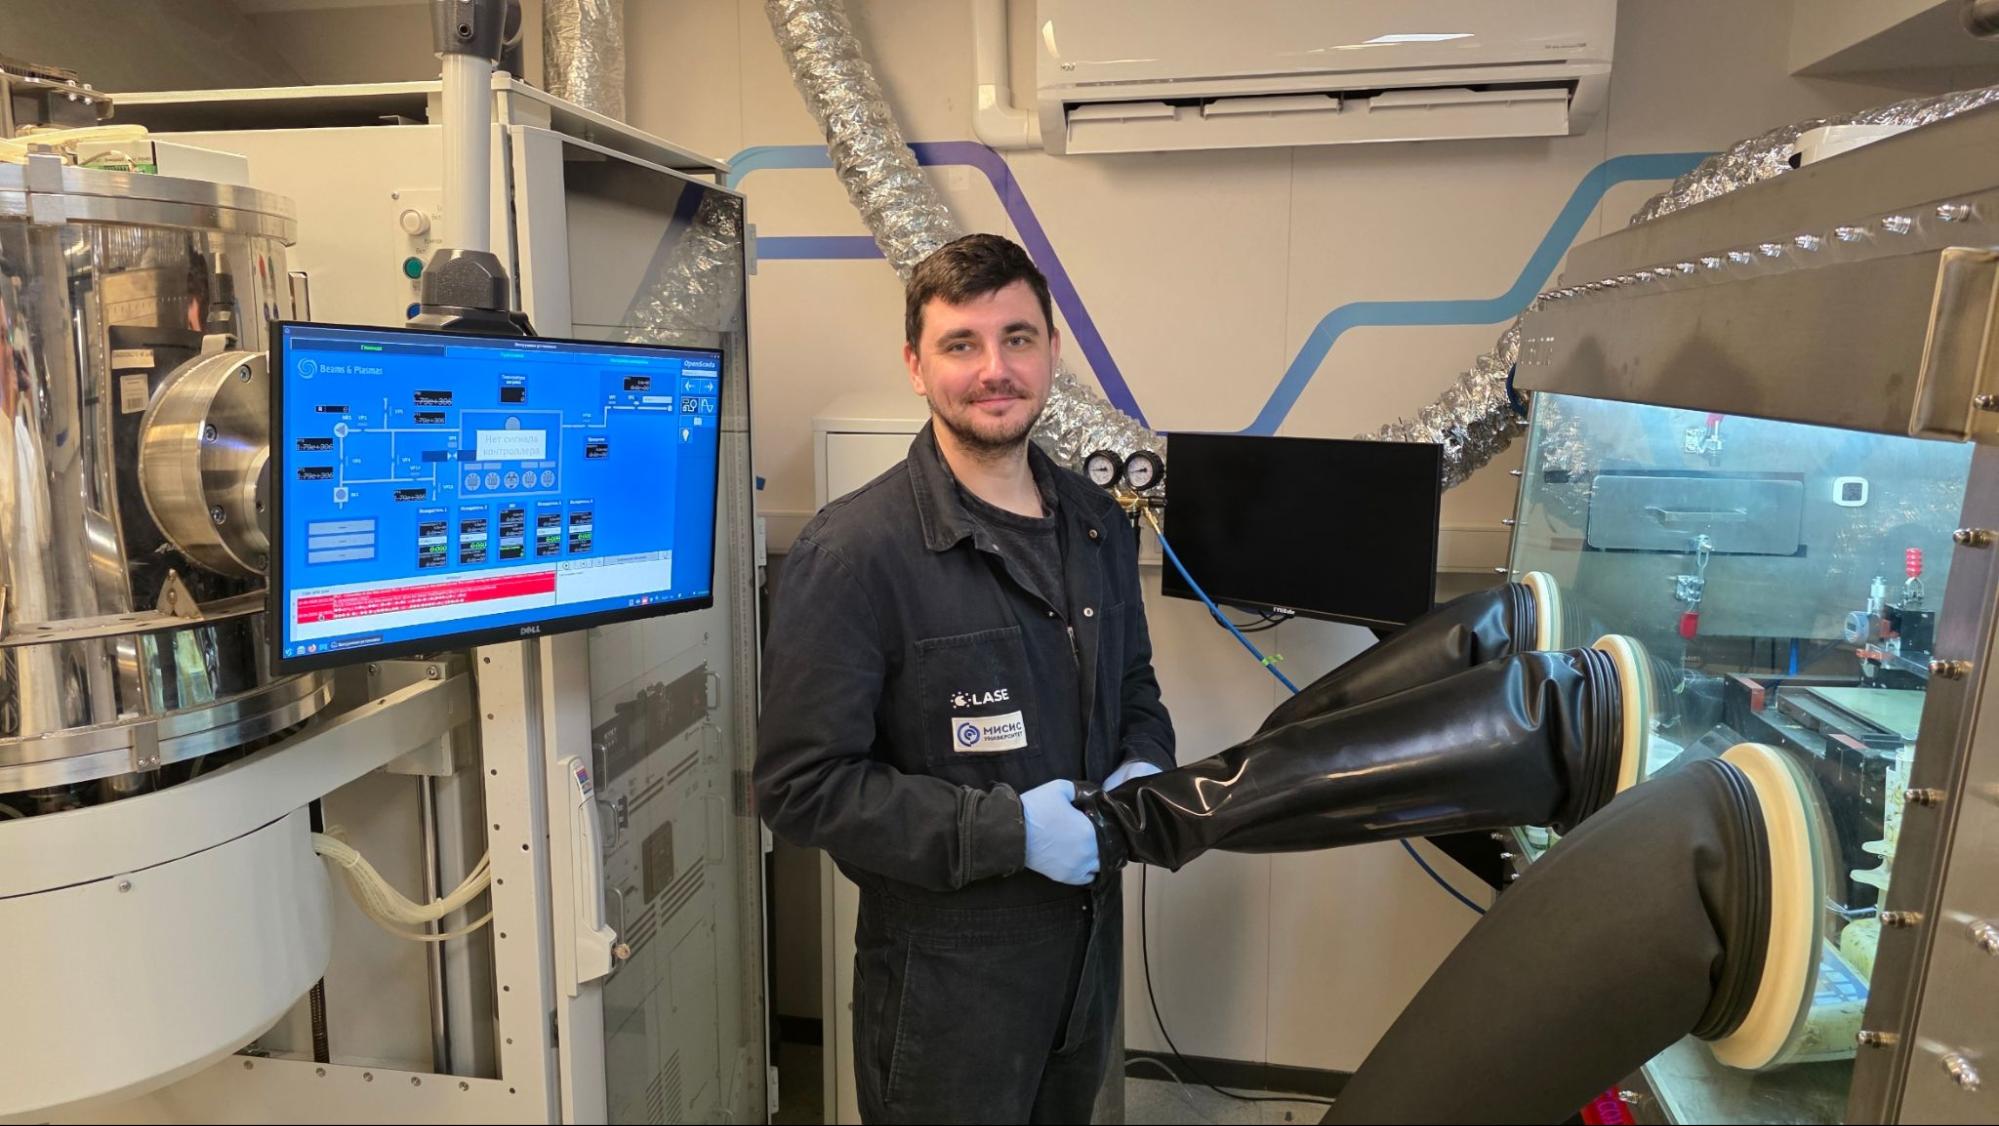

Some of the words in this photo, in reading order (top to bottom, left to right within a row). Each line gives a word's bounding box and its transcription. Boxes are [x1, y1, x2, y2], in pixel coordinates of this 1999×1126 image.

[320, 364, 345, 374] Beams
[354, 366, 383, 375] Plasmas
[684, 360, 715, 368] OpenScada
[520, 625, 541, 635] DELL
[972, 688, 1010, 706] LASE
[983, 721, 1022, 736] МИСИС
[983, 731, 1024, 742] УНИВЕРСИТЕТ
